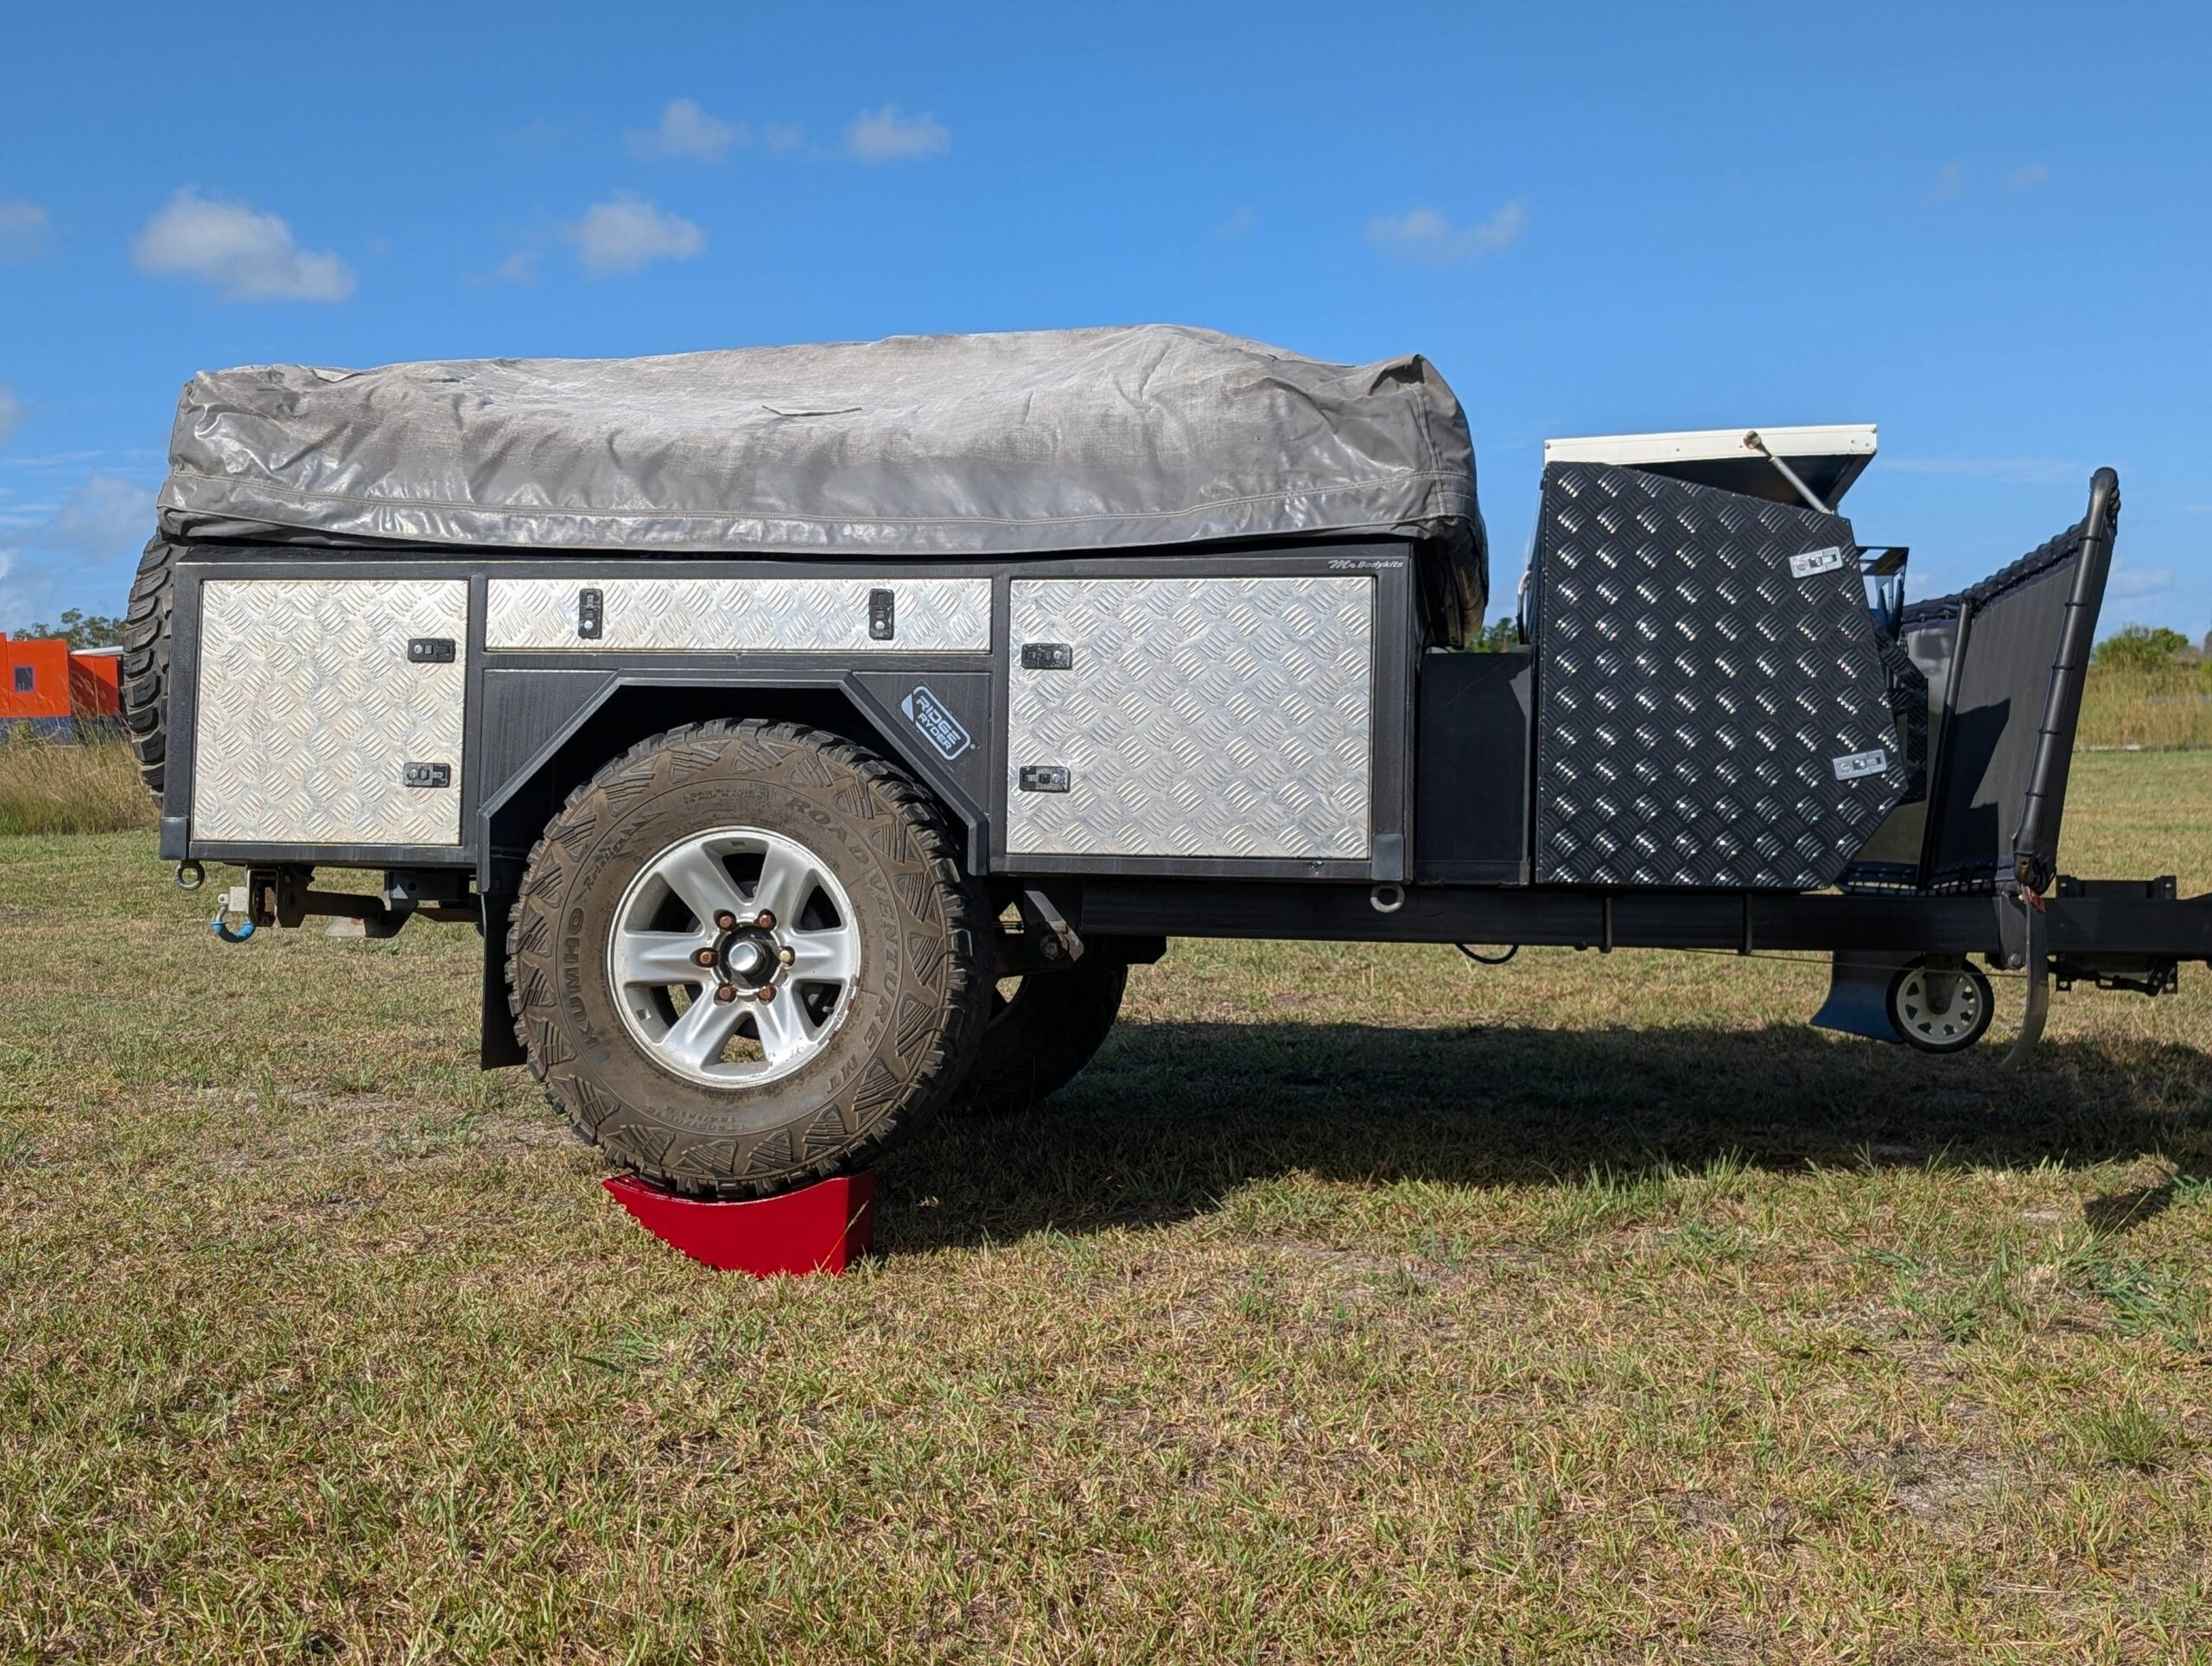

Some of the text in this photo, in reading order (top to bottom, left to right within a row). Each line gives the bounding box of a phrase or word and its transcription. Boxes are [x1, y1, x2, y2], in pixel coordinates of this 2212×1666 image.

[916, 696, 962, 745] RIDGE
[917, 713, 952, 750] RYDER
[785, 797, 870, 864] ROAD
[583, 836, 627, 891] Rotation
[564, 907, 601, 1050] KUMHO
[864, 866, 899, 1052] VENTURE
[826, 1053, 858, 1095] MT
